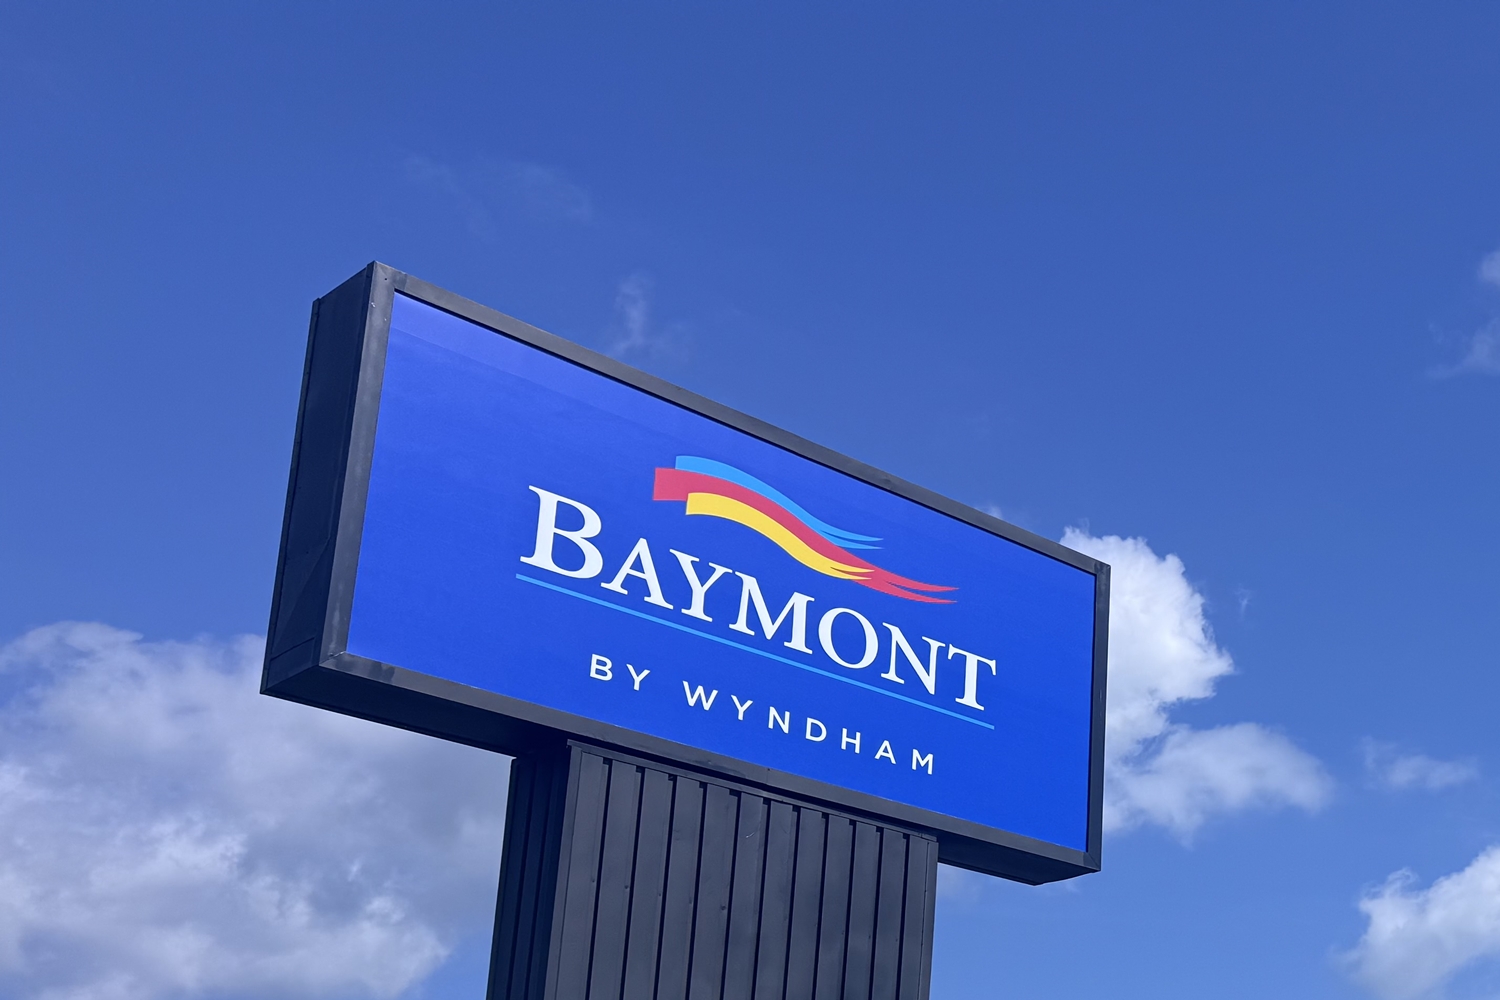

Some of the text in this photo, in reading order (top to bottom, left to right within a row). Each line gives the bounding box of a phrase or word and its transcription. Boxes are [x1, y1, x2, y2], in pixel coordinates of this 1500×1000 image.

[519, 485, 997, 711] BAYMONT
[589, 653, 934, 775] BY WYNDHAM
